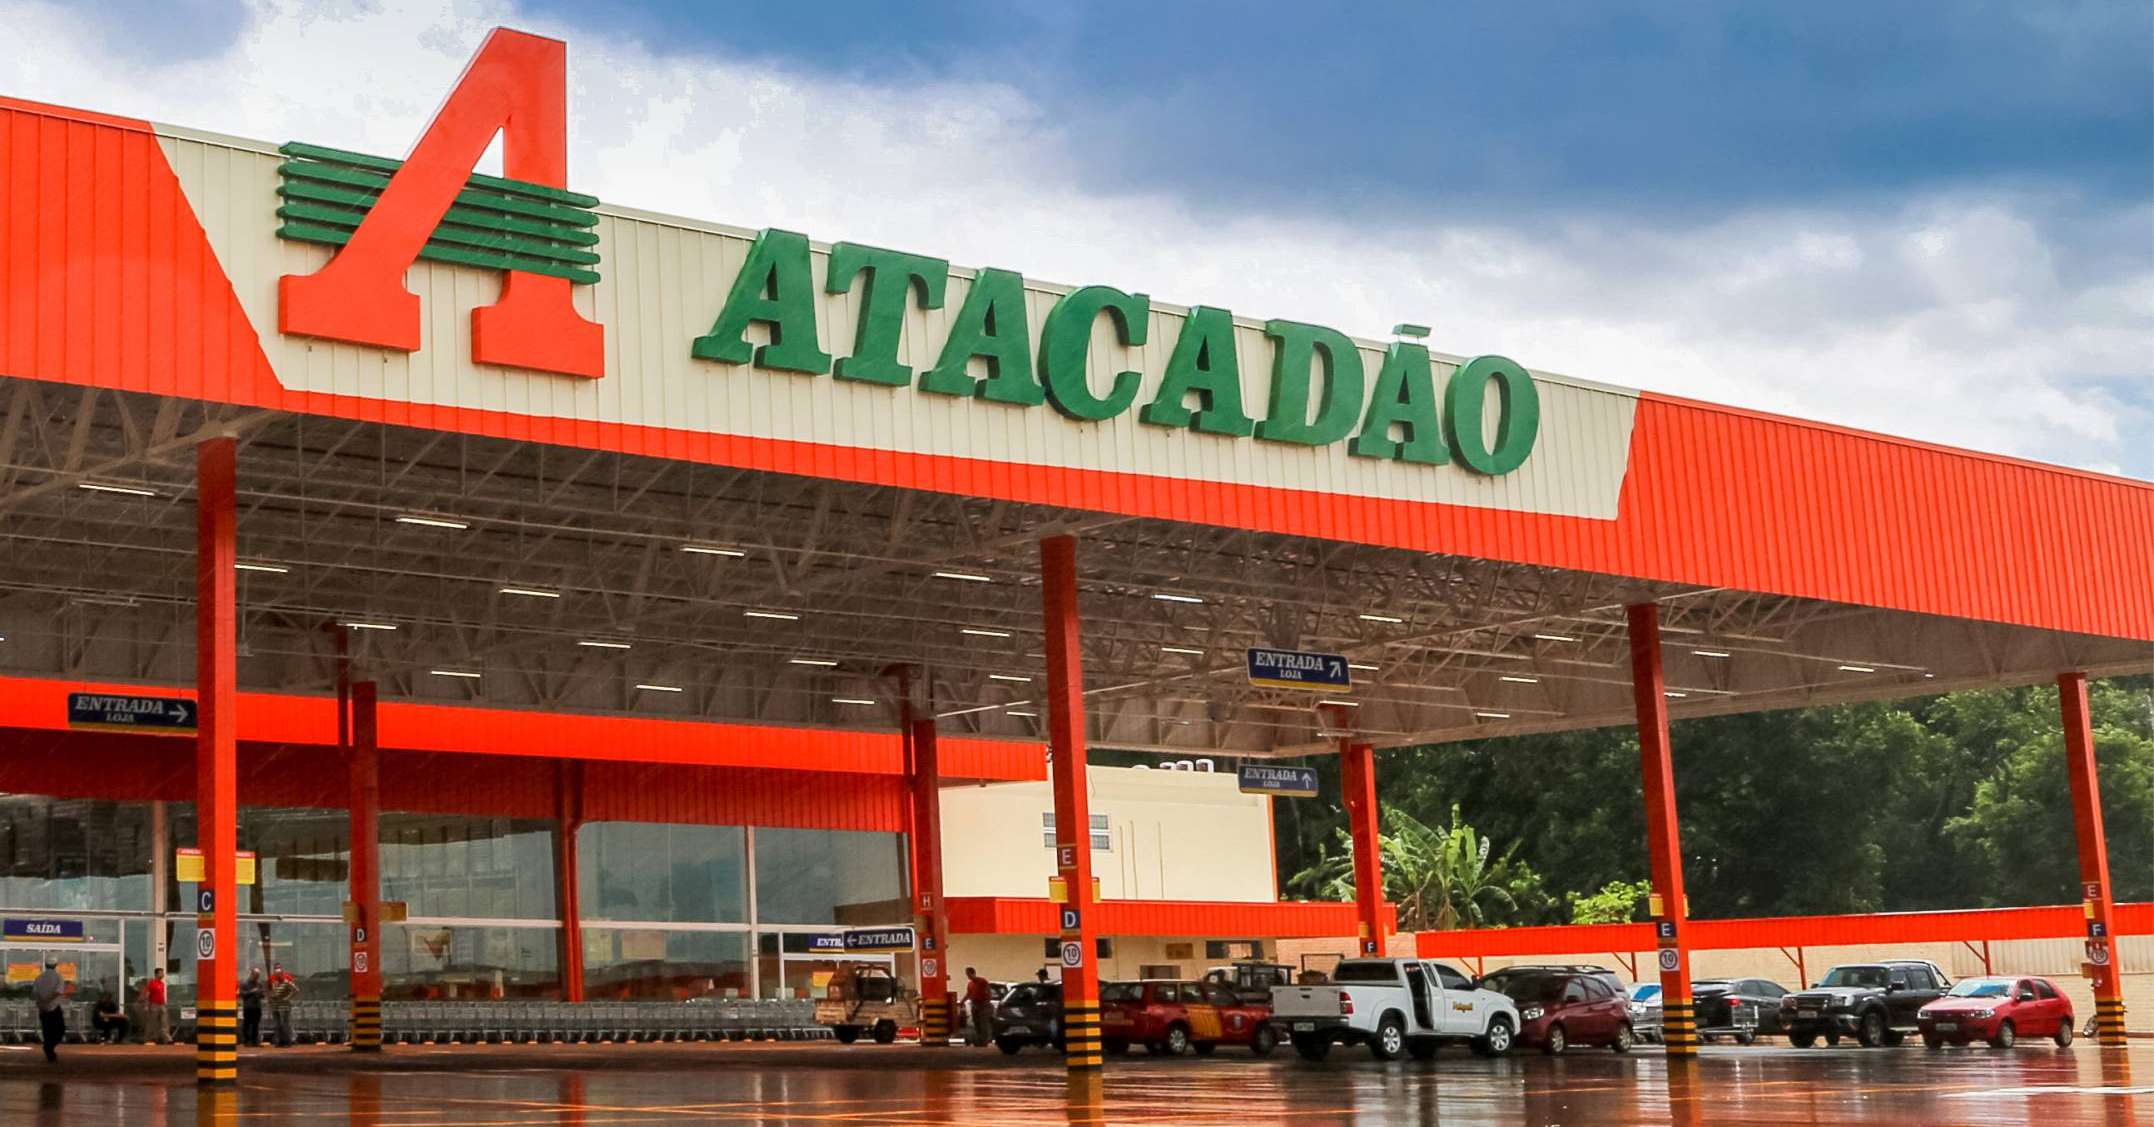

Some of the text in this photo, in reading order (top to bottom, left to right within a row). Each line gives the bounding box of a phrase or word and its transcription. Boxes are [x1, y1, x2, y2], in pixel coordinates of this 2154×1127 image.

[278, 27, 604, 379] A
[692, 228, 1540, 476] ATACADÃO
[1255, 652, 1325, 671] ENTRADA
[1280, 669, 1302, 679] LOJA
[75, 696, 164, 715] ENTRADA
[106, 713, 135, 723] LOJA
[1244, 767, 1297, 781] ENTRADA
[1061, 848, 1072, 865] E
[2087, 884, 2097, 897] E
[201, 891, 212, 911] C
[922, 896, 931, 907] H
[1064, 911, 1077, 928] D
[25, 921, 61, 934] SAÍDA
[1661, 922, 1672, 937] E
[2092, 924, 2102, 936] F
[356, 928, 365, 941] D
[858, 932, 911, 946] ENTRADA
[816, 937, 844, 947] ENTR
[925, 938, 932, 949] E
[1367, 941, 1374, 952] F
